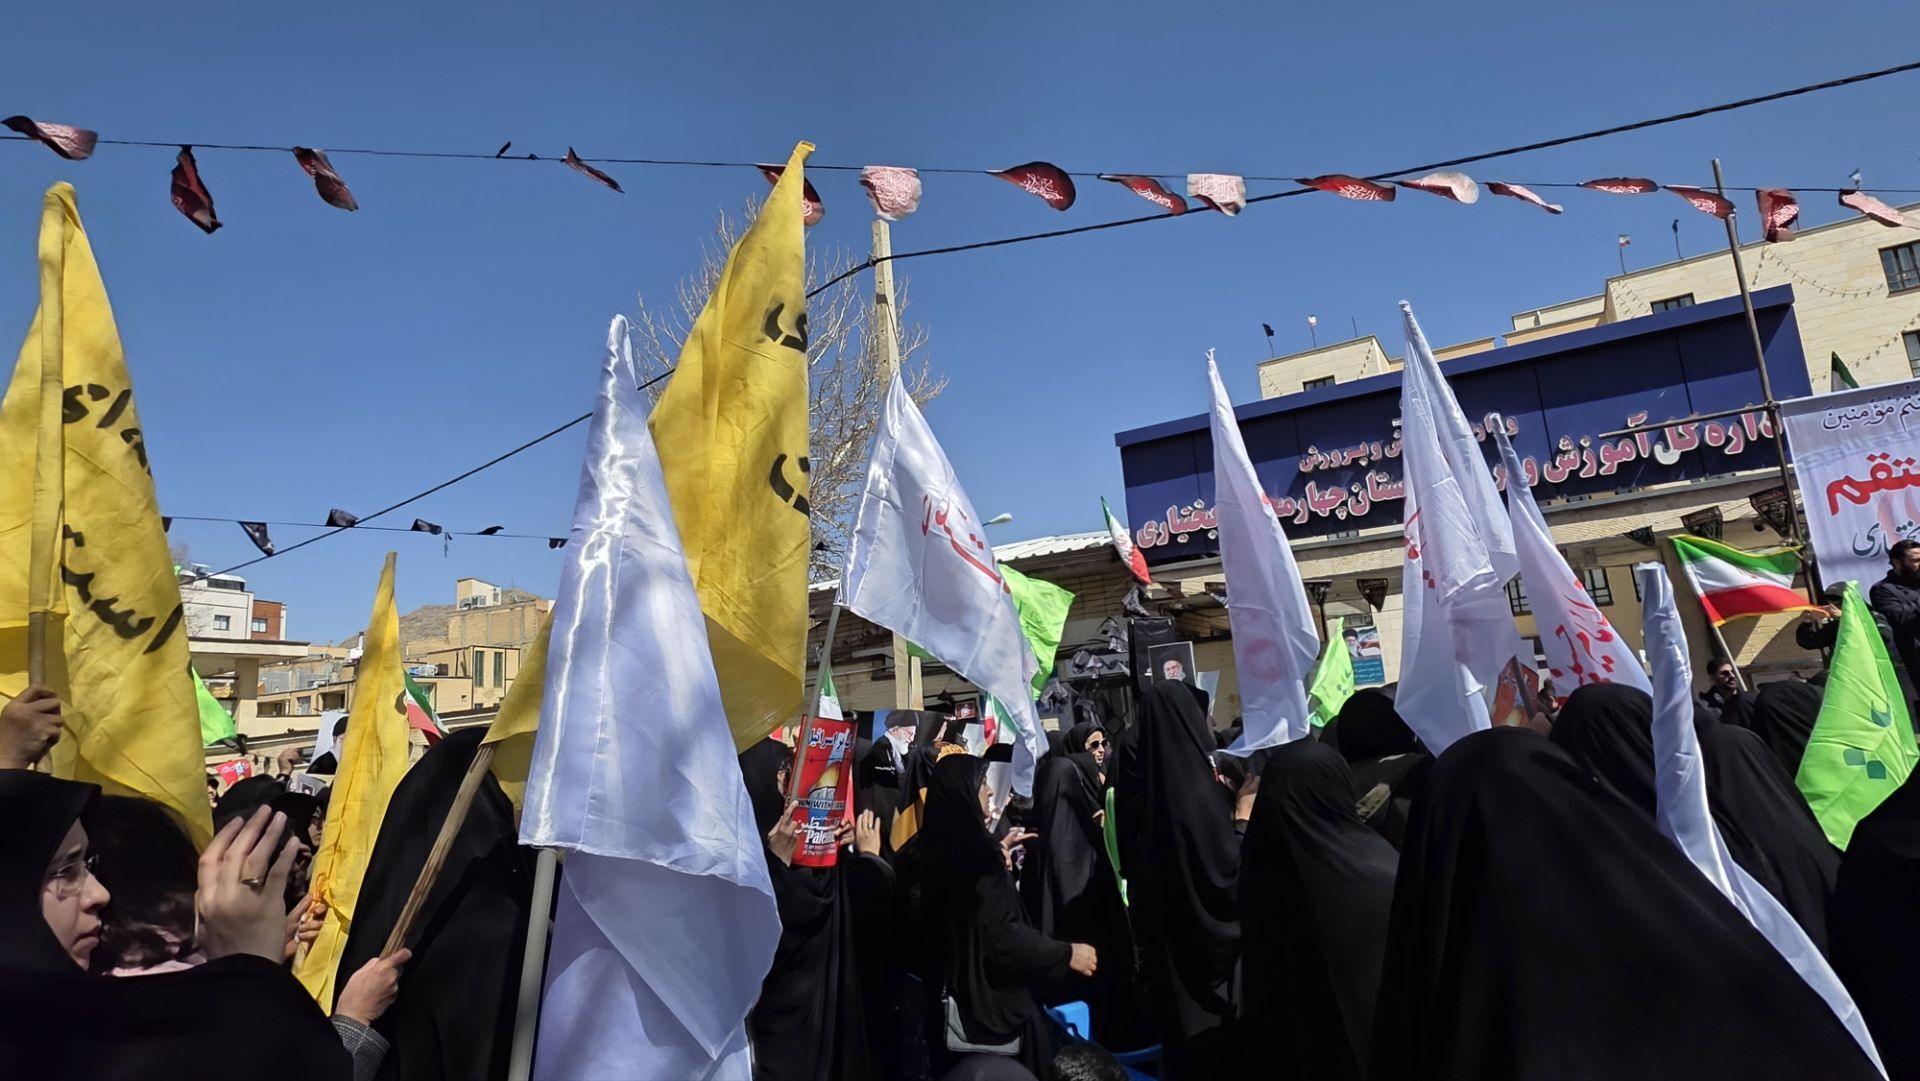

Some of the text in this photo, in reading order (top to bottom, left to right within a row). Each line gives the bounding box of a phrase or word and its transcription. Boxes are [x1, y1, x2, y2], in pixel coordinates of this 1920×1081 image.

[1299, 441, 1370, 473] پرورش
[1544, 411, 1650, 483] آموزش
[1654, 412, 1700, 466] کل
[1348, 470, 1405, 516] ستان
